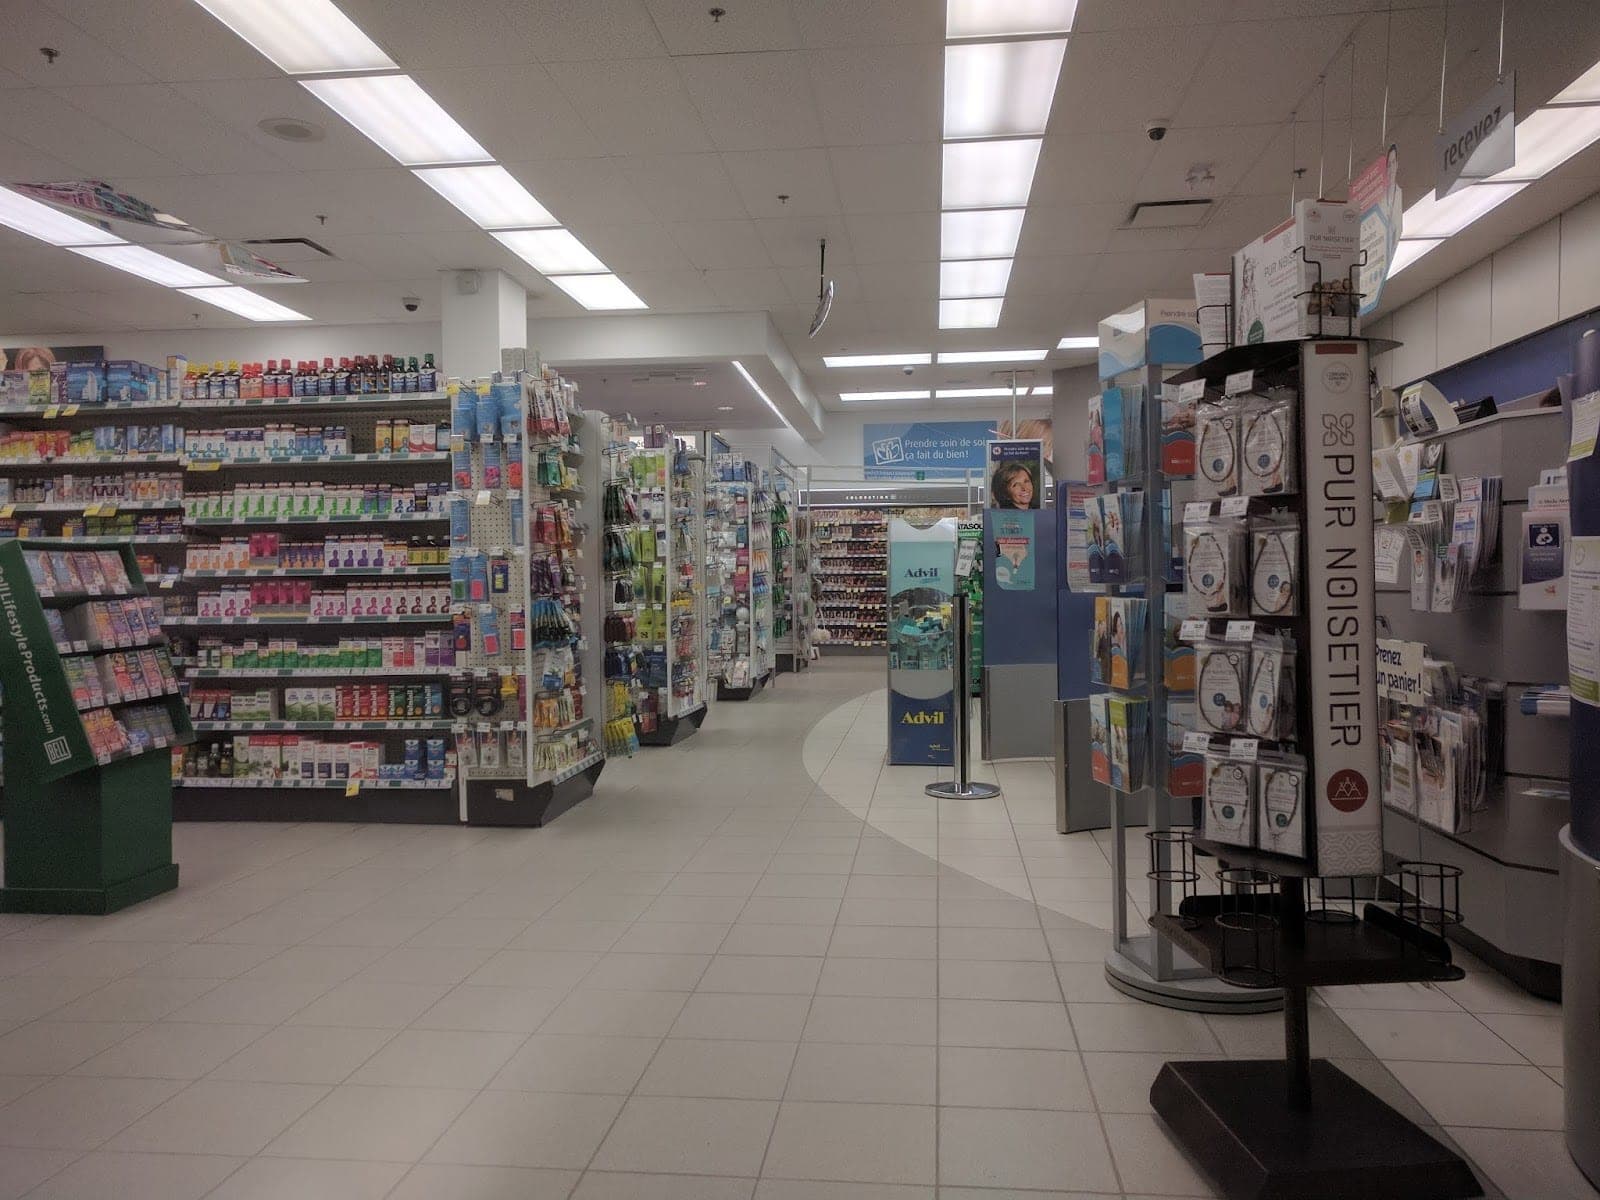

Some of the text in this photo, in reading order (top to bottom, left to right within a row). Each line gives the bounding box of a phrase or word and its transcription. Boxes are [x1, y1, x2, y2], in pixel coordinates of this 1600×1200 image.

[905, 438, 938, 448] Prendre
[940, 438, 958, 447] soin
[960, 438, 971, 447] de
[905, 450, 969, 460] ça fait du bien!
[904, 567, 938, 578] Advil
[1324, 454, 1362, 747] PUR NOISETIER
[901, 711, 945, 725] Advil
